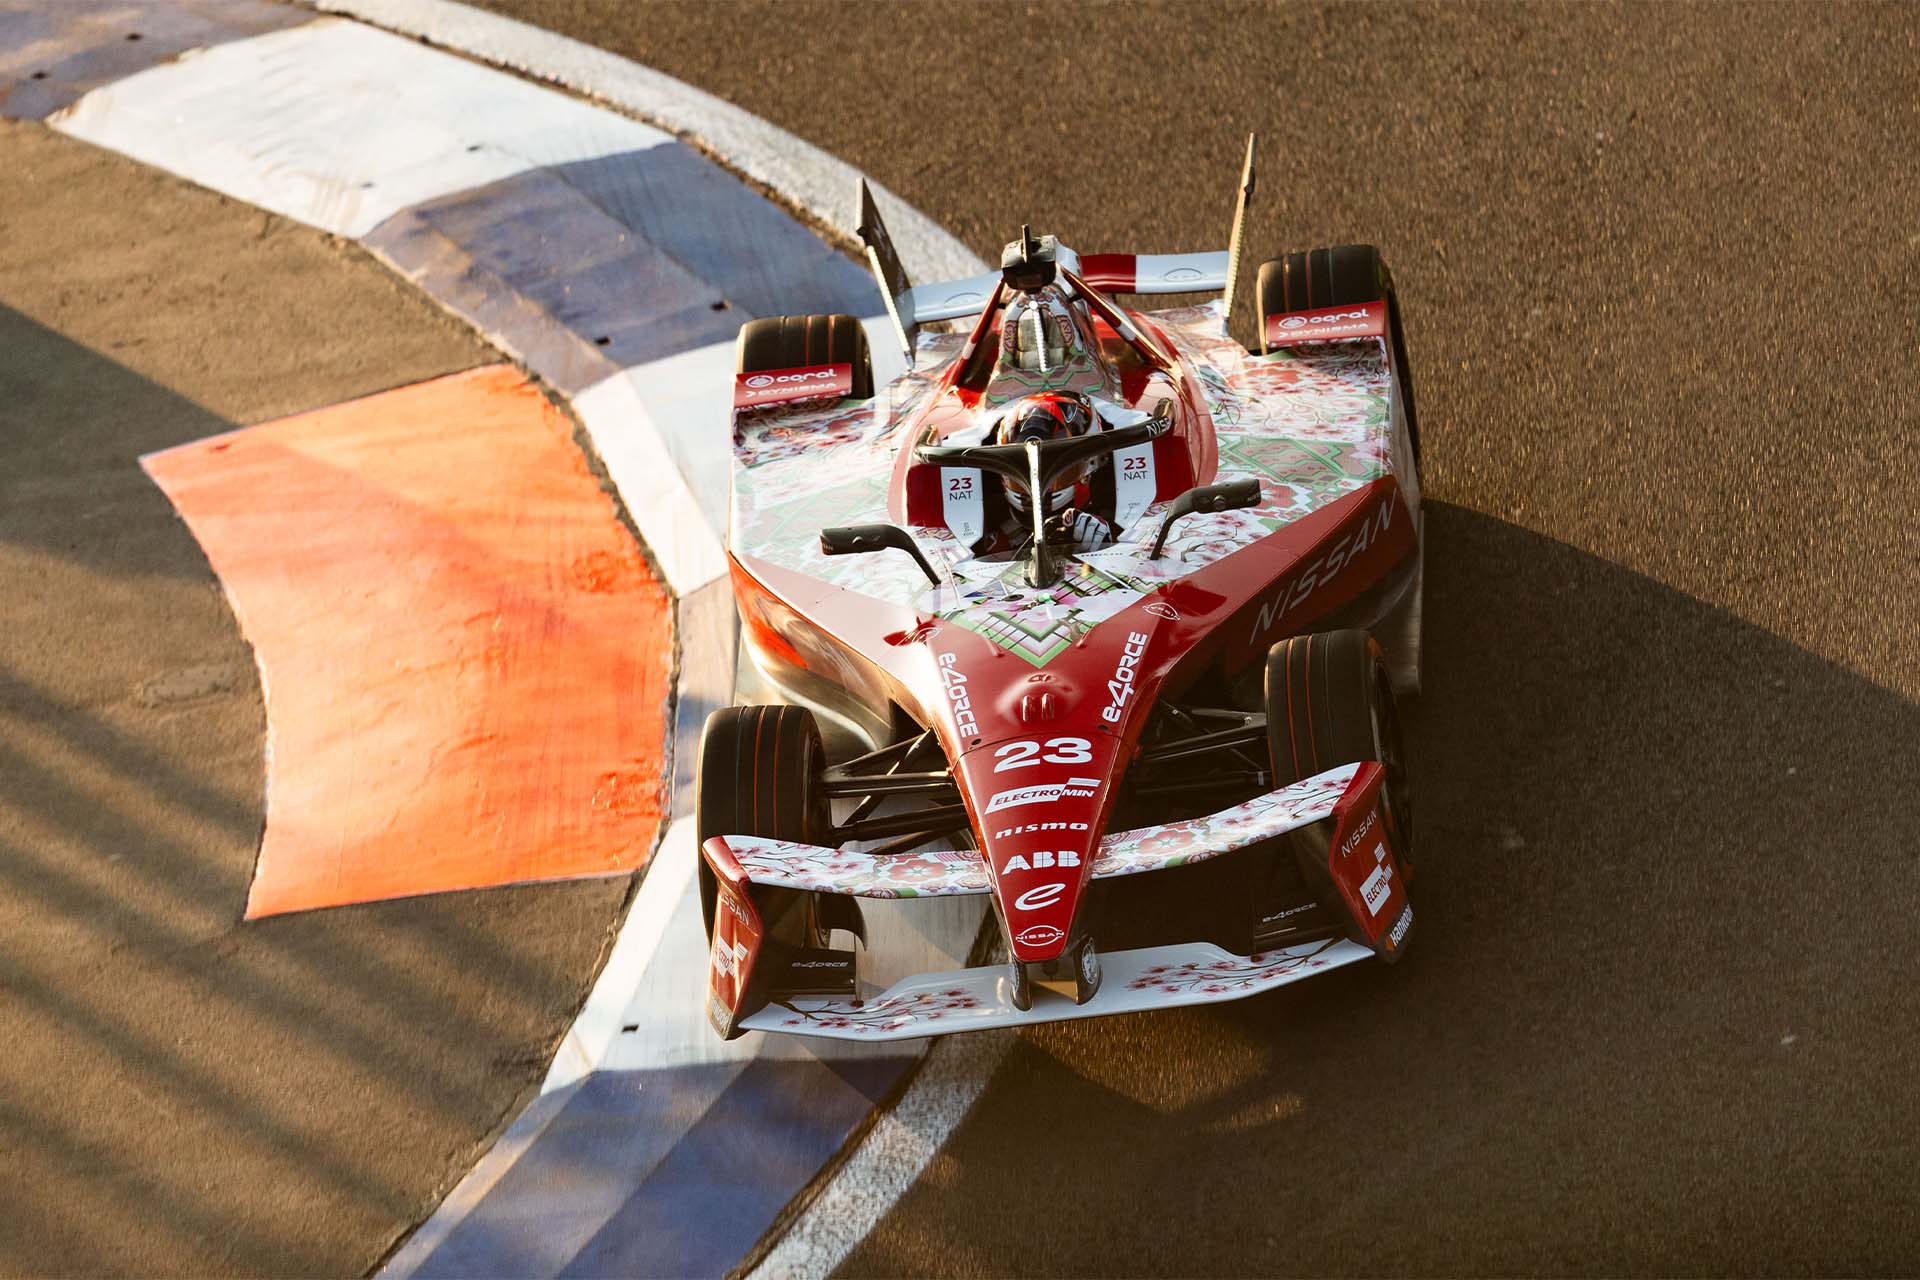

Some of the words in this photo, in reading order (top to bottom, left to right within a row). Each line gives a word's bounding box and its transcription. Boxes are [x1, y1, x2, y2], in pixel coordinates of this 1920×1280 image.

[1123, 456, 1146, 471] 23
[949, 477, 972, 491] 23
[1123, 470, 1148, 481] NAT
[949, 490, 974, 501] NAT
[1250, 487, 1397, 646] NISSAN
[993, 737, 1093, 774] 23
[994, 788, 1095, 806] ELECTROMIN
[995, 822, 1089, 840] nismo
[1341, 809, 1377, 858] NISSAN
[1001, 851, 1081, 875] ABB
[1015, 930, 1065, 942] NISSAN
